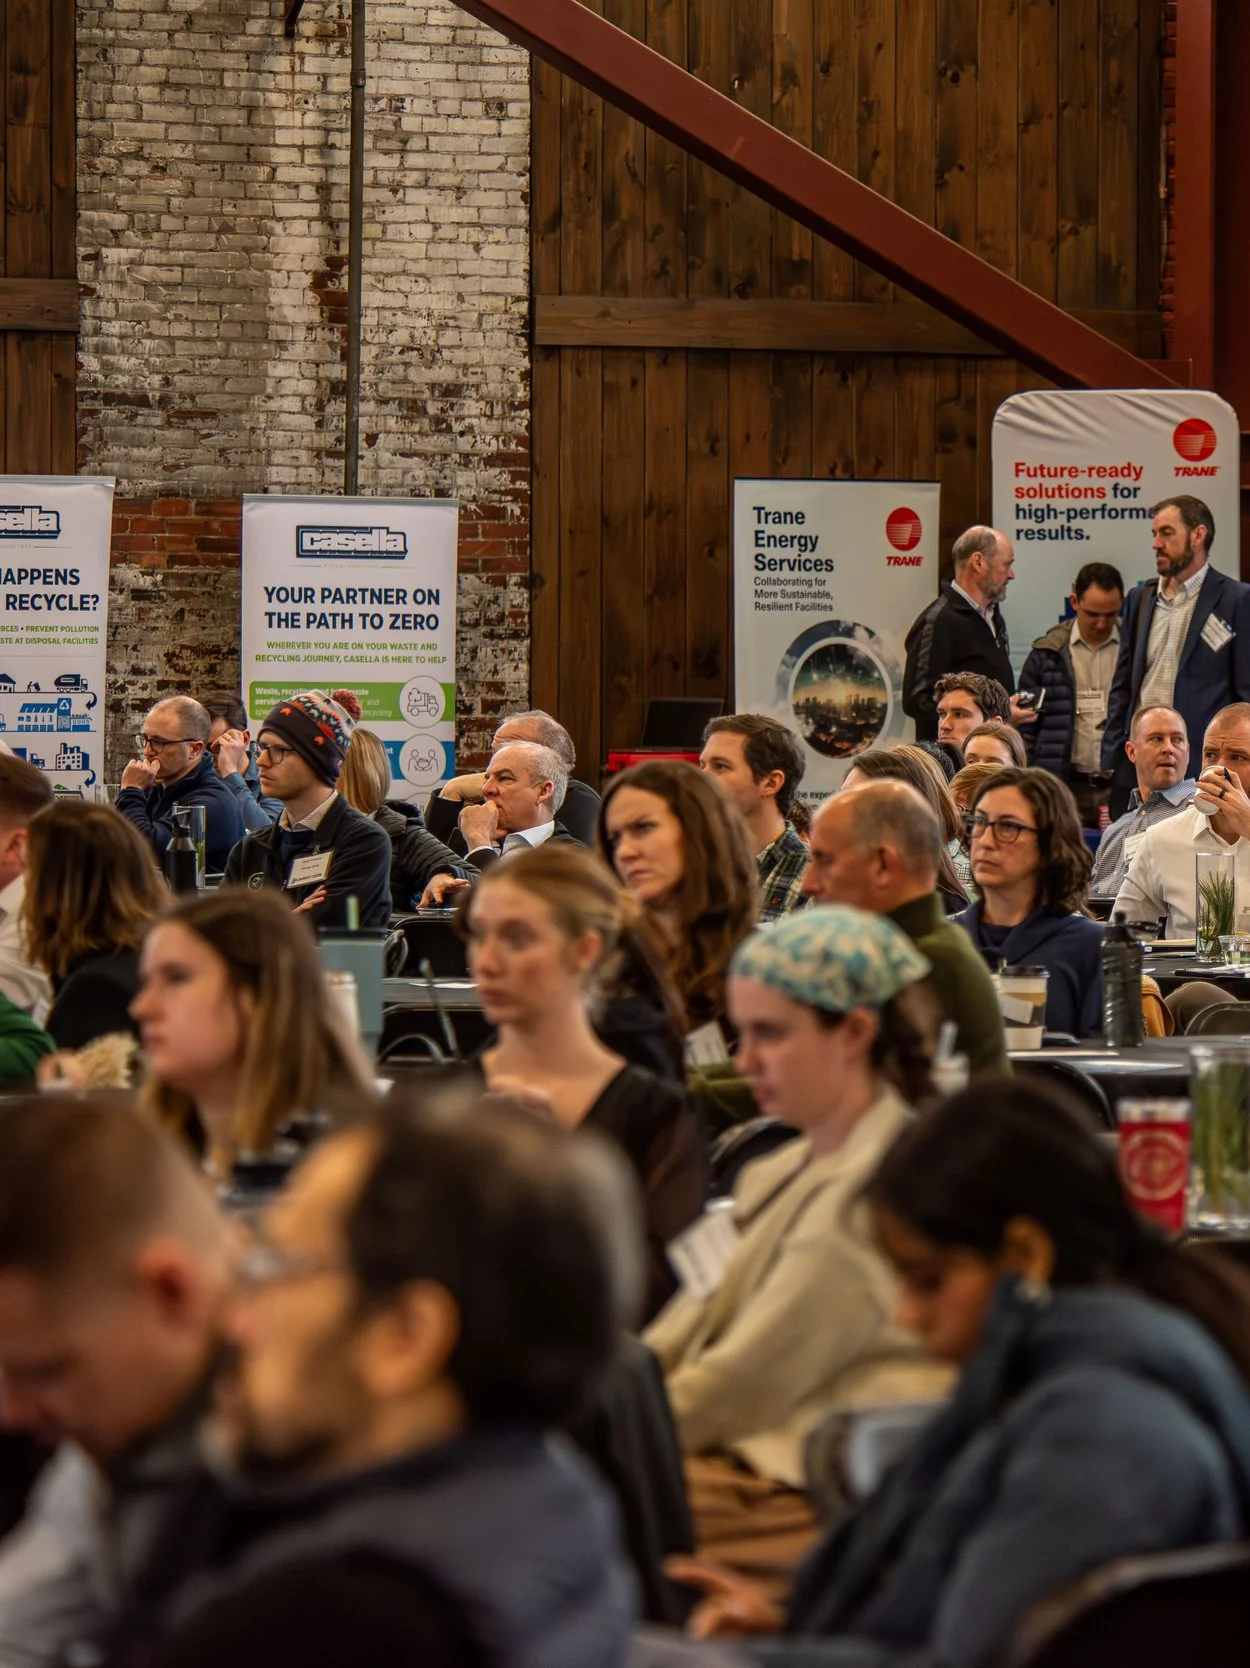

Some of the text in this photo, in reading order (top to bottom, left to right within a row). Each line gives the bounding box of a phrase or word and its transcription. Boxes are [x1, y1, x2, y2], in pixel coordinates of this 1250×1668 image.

[1014, 461, 1144, 481] Future-ready
[1174, 466, 1218, 477] TRANE
[1015, 482, 1141, 499] solutions for
[752, 506, 805, 525] Trane
[299, 526, 406, 556] casella
[1015, 525, 1091, 541] results.
[754, 530, 819, 553] Energy
[754, 553, 835, 573] Services
[886, 556, 924, 567] TRANE
[0, 568, 81, 586] APPENS
[754, 576, 827, 588] Collaborating for
[5, 593, 100, 611] RECYCLE?
[263, 586, 441, 605] YOUR PARTNER ON
[754, 589, 834, 601] More Sustainable,
[754, 602, 834, 612] Resilient Facilities
[25, 625, 59, 633] PREVENT
[60, 625, 100, 633] POLLUTION
[264, 611, 440, 631] THE PATH TO ZERO
[14, 637, 24, 645] AT
[25, 637, 62, 645] DISPOSAL
[62, 637, 99, 645] FACILITIES
[266, 641, 438, 651] WHEREVER YOU ARE ON YOUR WASTE AND
[255, 654, 447, 664] RECYCLING JOURNEY, CASELLA IS HERE TO HELP
[255, 687, 280, 696] Waste,
